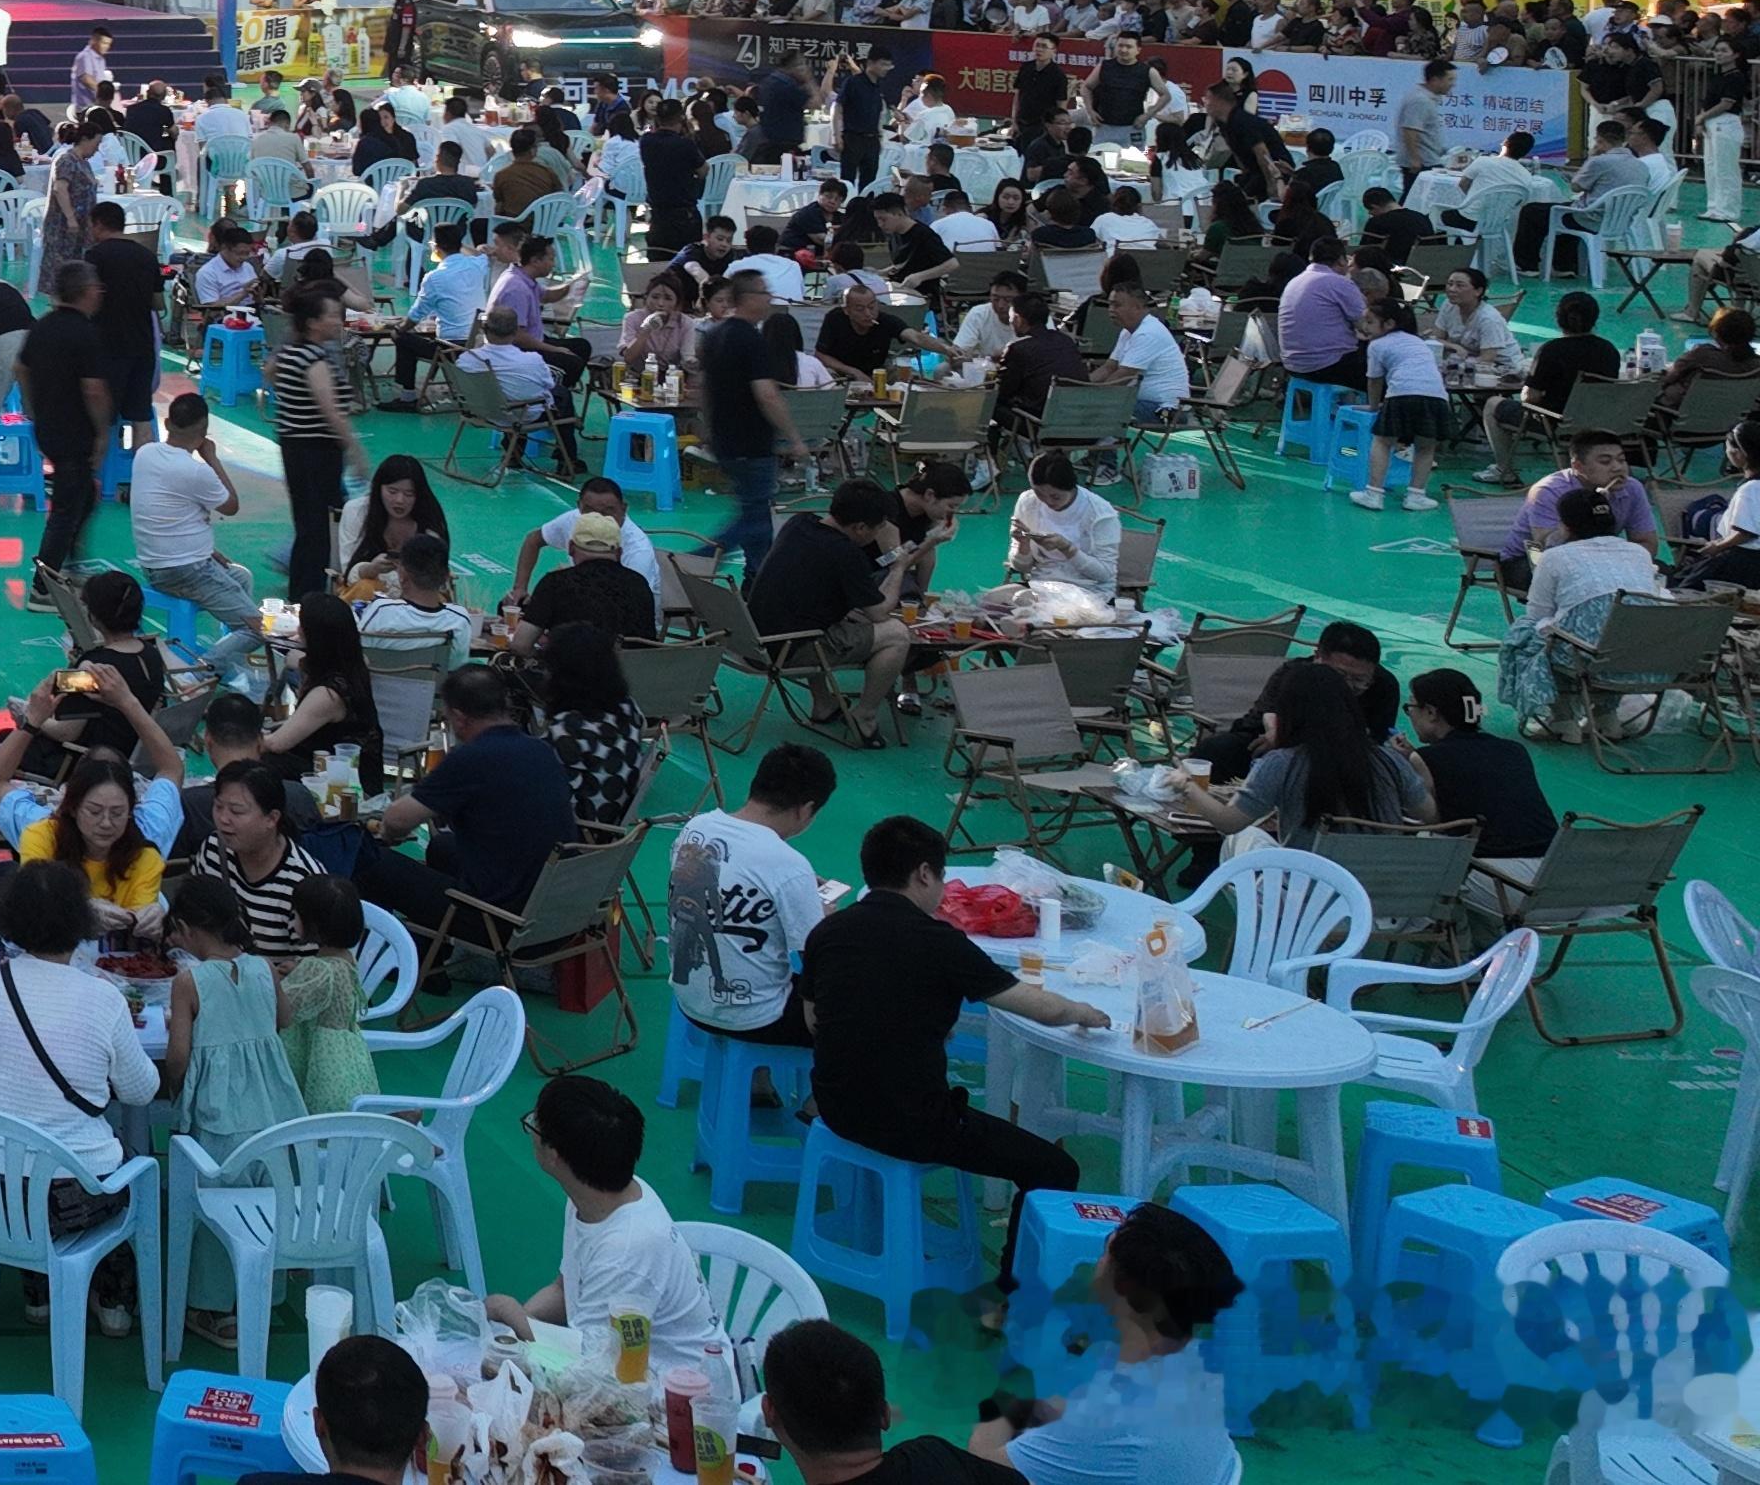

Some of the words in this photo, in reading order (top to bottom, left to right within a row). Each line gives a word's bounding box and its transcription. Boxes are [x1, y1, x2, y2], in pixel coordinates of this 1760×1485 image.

[1308, 83, 1388, 107] 四川中孚
[1484, 95, 1545, 113] 精诚团结
[1308, 110, 1344, 119] SICHUAN
[1348, 112, 1388, 122] ZHONGFU
[1483, 114, 1544, 134] 创新发展
